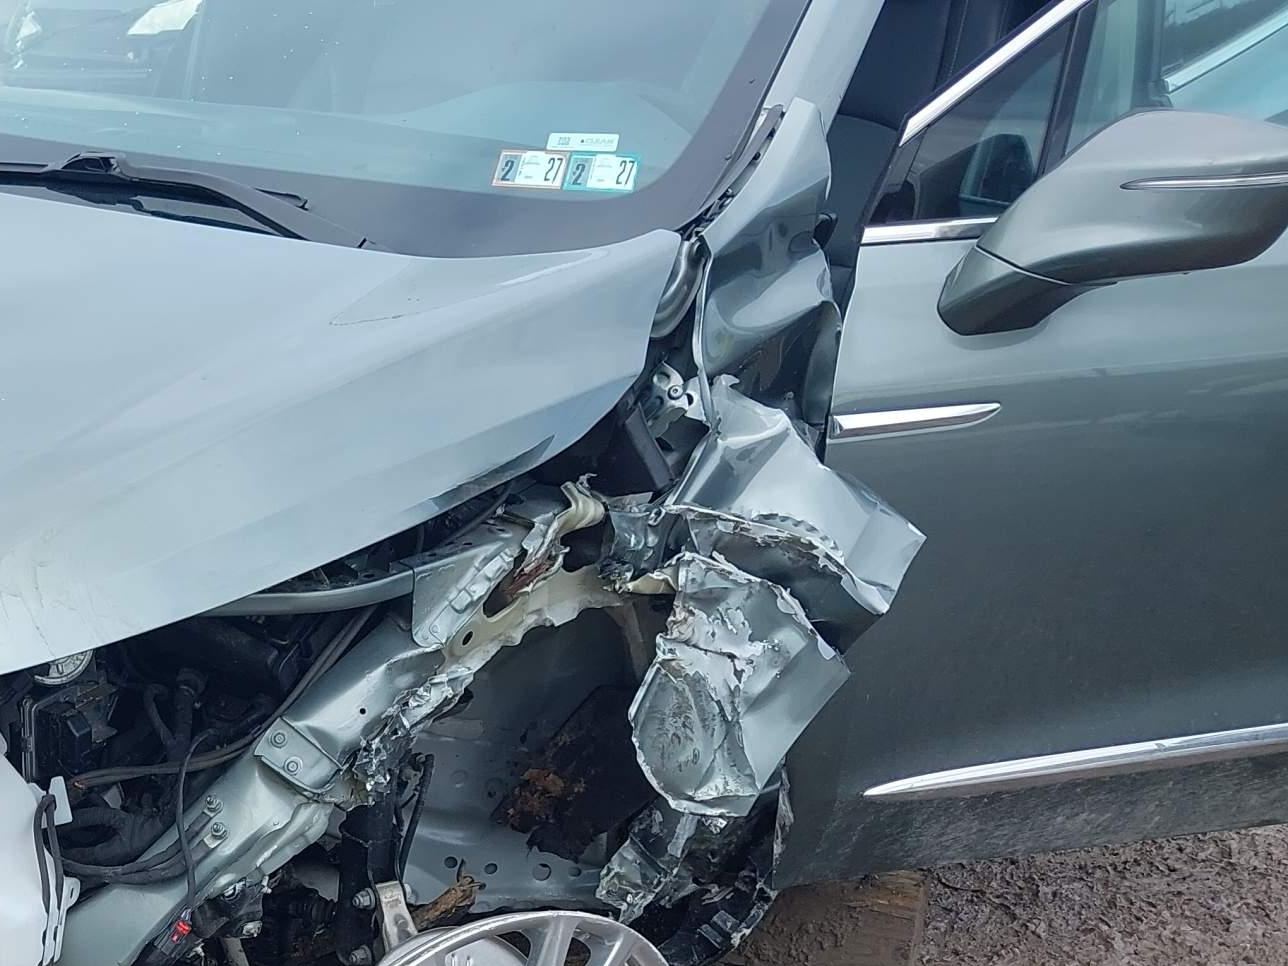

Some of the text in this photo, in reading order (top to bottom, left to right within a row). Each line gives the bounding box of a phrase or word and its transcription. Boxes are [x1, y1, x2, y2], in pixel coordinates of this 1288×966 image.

[501, 157, 564, 184] 2 27
[573, 159, 636, 186] 2 27
